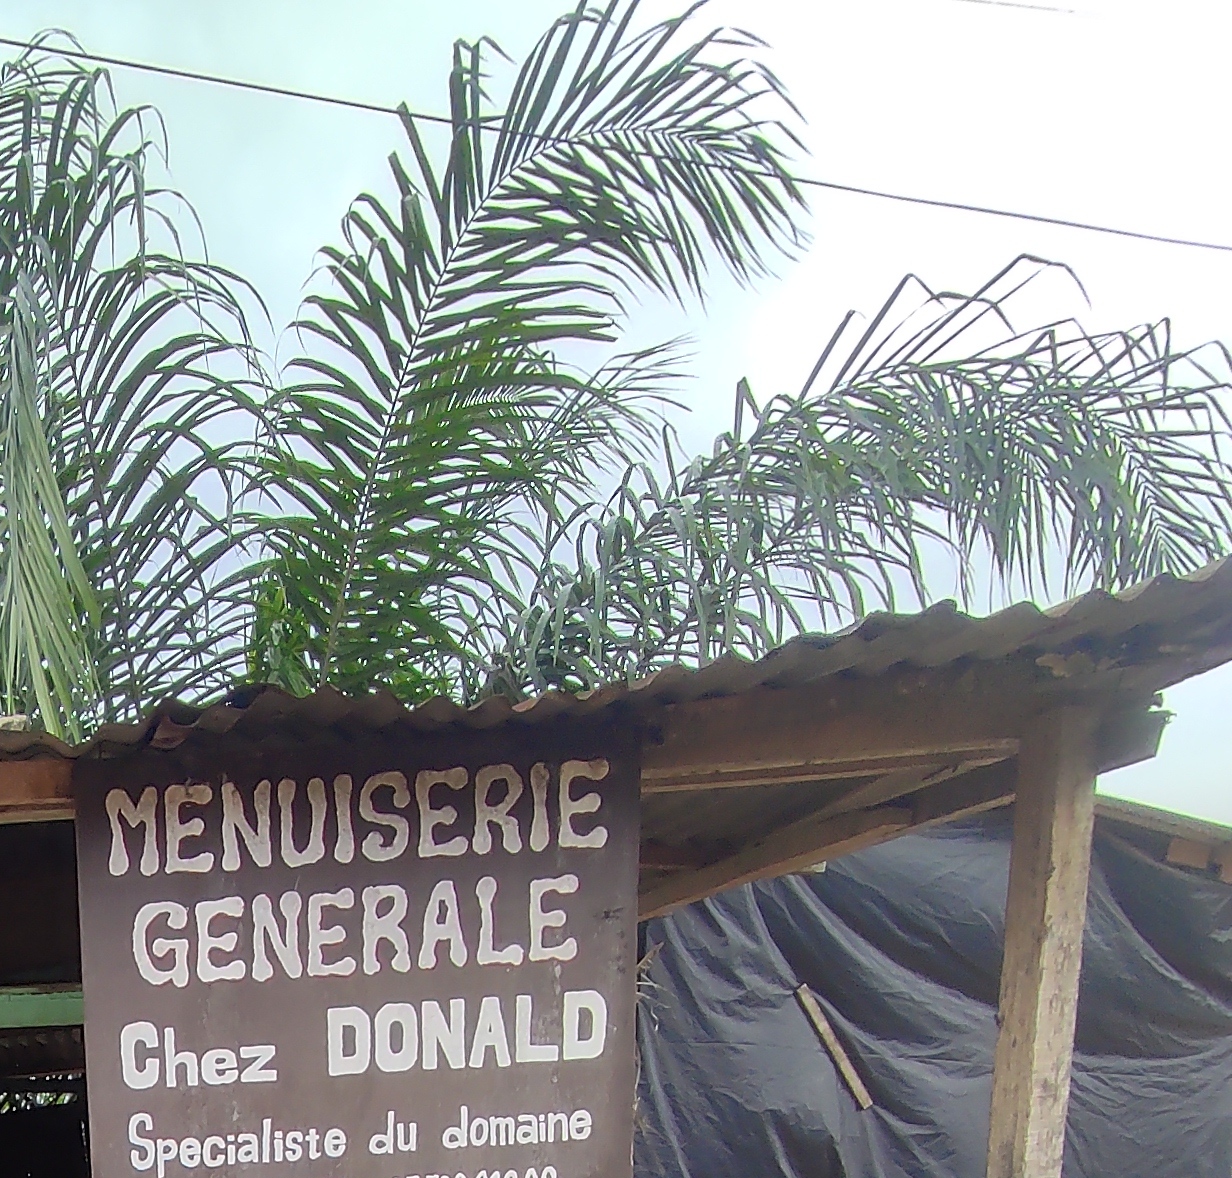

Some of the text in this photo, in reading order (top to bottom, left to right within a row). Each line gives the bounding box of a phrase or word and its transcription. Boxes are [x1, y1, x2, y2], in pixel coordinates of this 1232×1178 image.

[105, 759, 609, 876] MENUISERIE
[133, 875, 579, 987] GENERALE
[121, 990, 608, 1089] Chez DONALD
[127, 1106, 593, 1178] Specialiste du domaine
